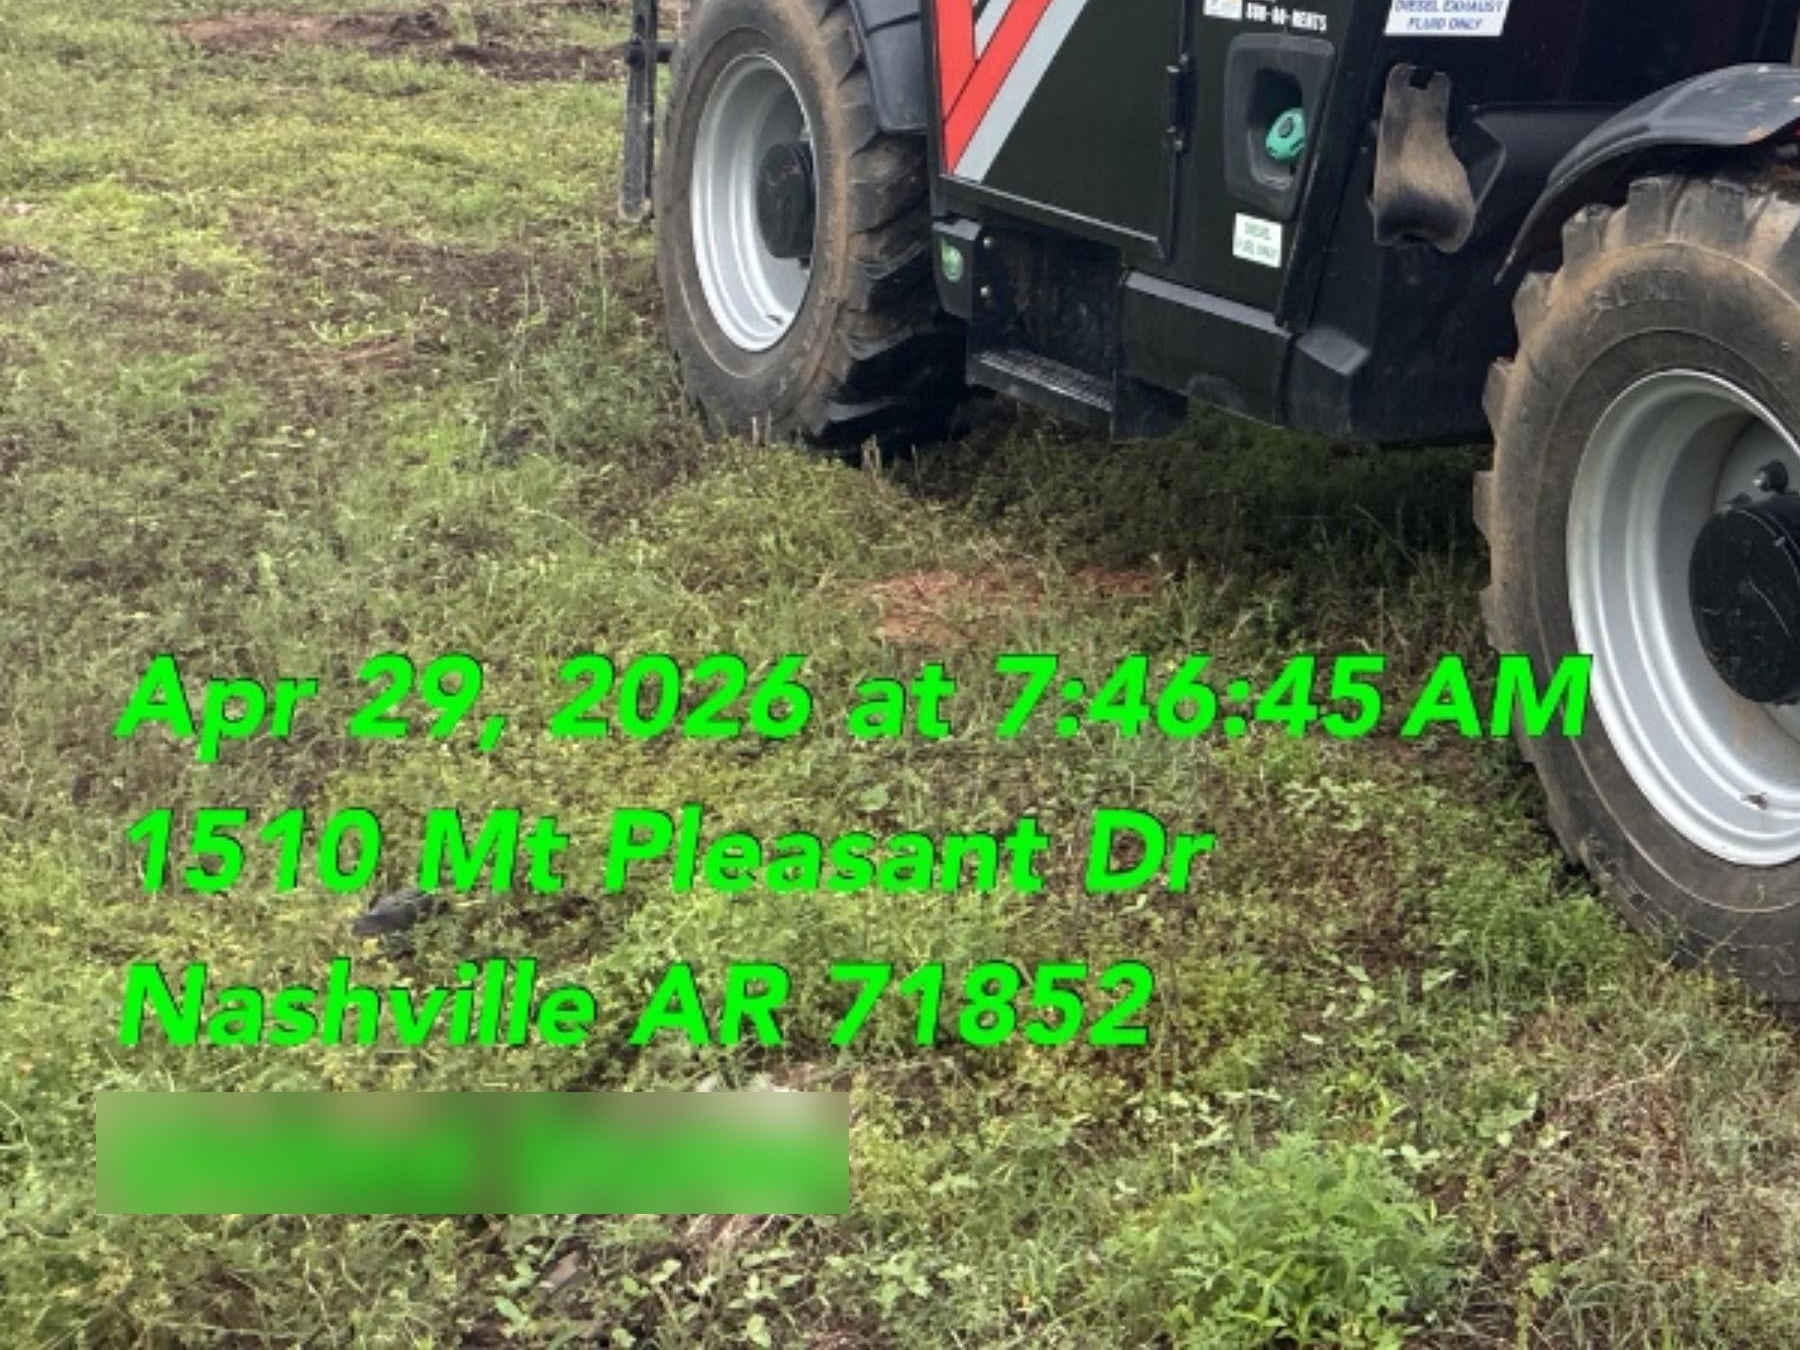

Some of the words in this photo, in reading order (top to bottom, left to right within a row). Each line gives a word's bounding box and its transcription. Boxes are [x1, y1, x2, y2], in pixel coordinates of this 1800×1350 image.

[1394, 0, 1438, 12] DIESEL
[1442, 0, 1505, 13] EXHAUST
[1407, 17, 1446, 30] FLUID
[1448, 17, 1484, 30] ONLY
